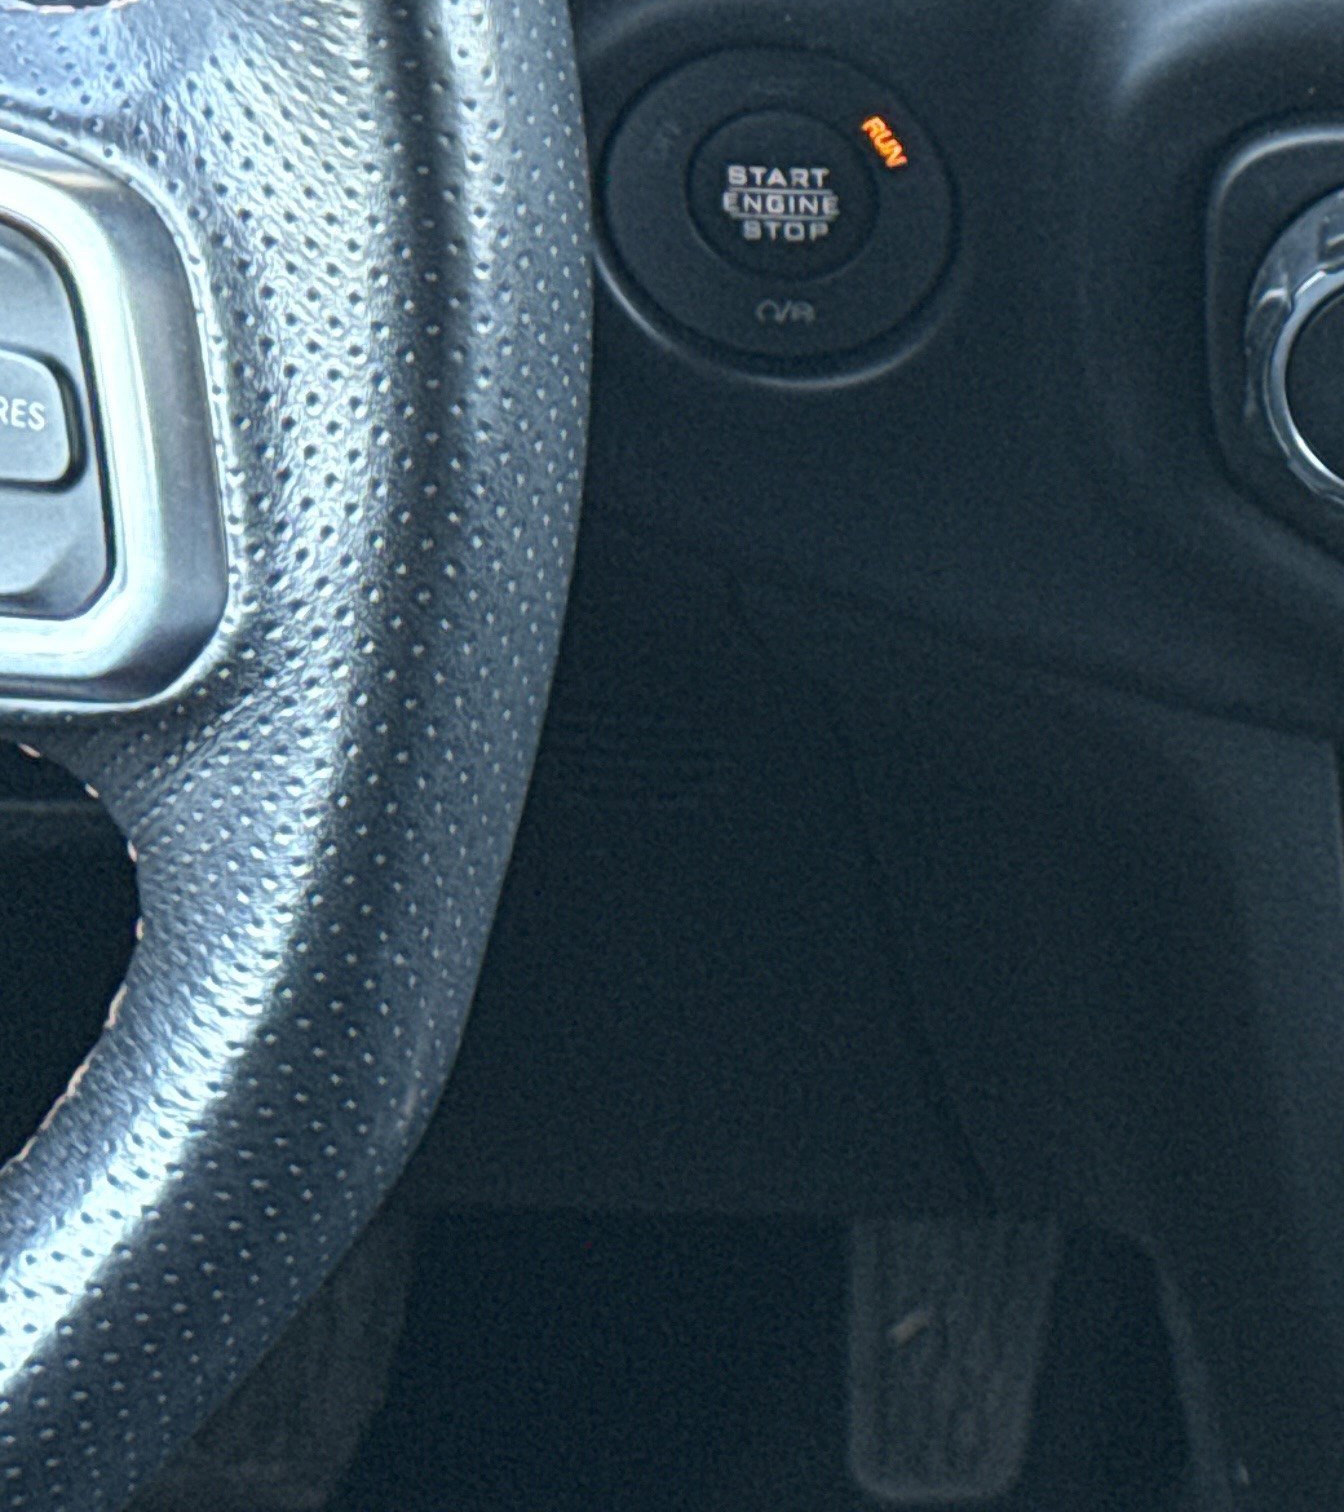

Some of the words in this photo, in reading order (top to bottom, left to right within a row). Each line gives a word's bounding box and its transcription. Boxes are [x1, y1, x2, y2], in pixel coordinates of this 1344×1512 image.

[861, 115, 908, 168] RUN
[726, 165, 830, 188] START
[722, 191, 841, 214] ENGINE
[741, 219, 831, 242] STOP
